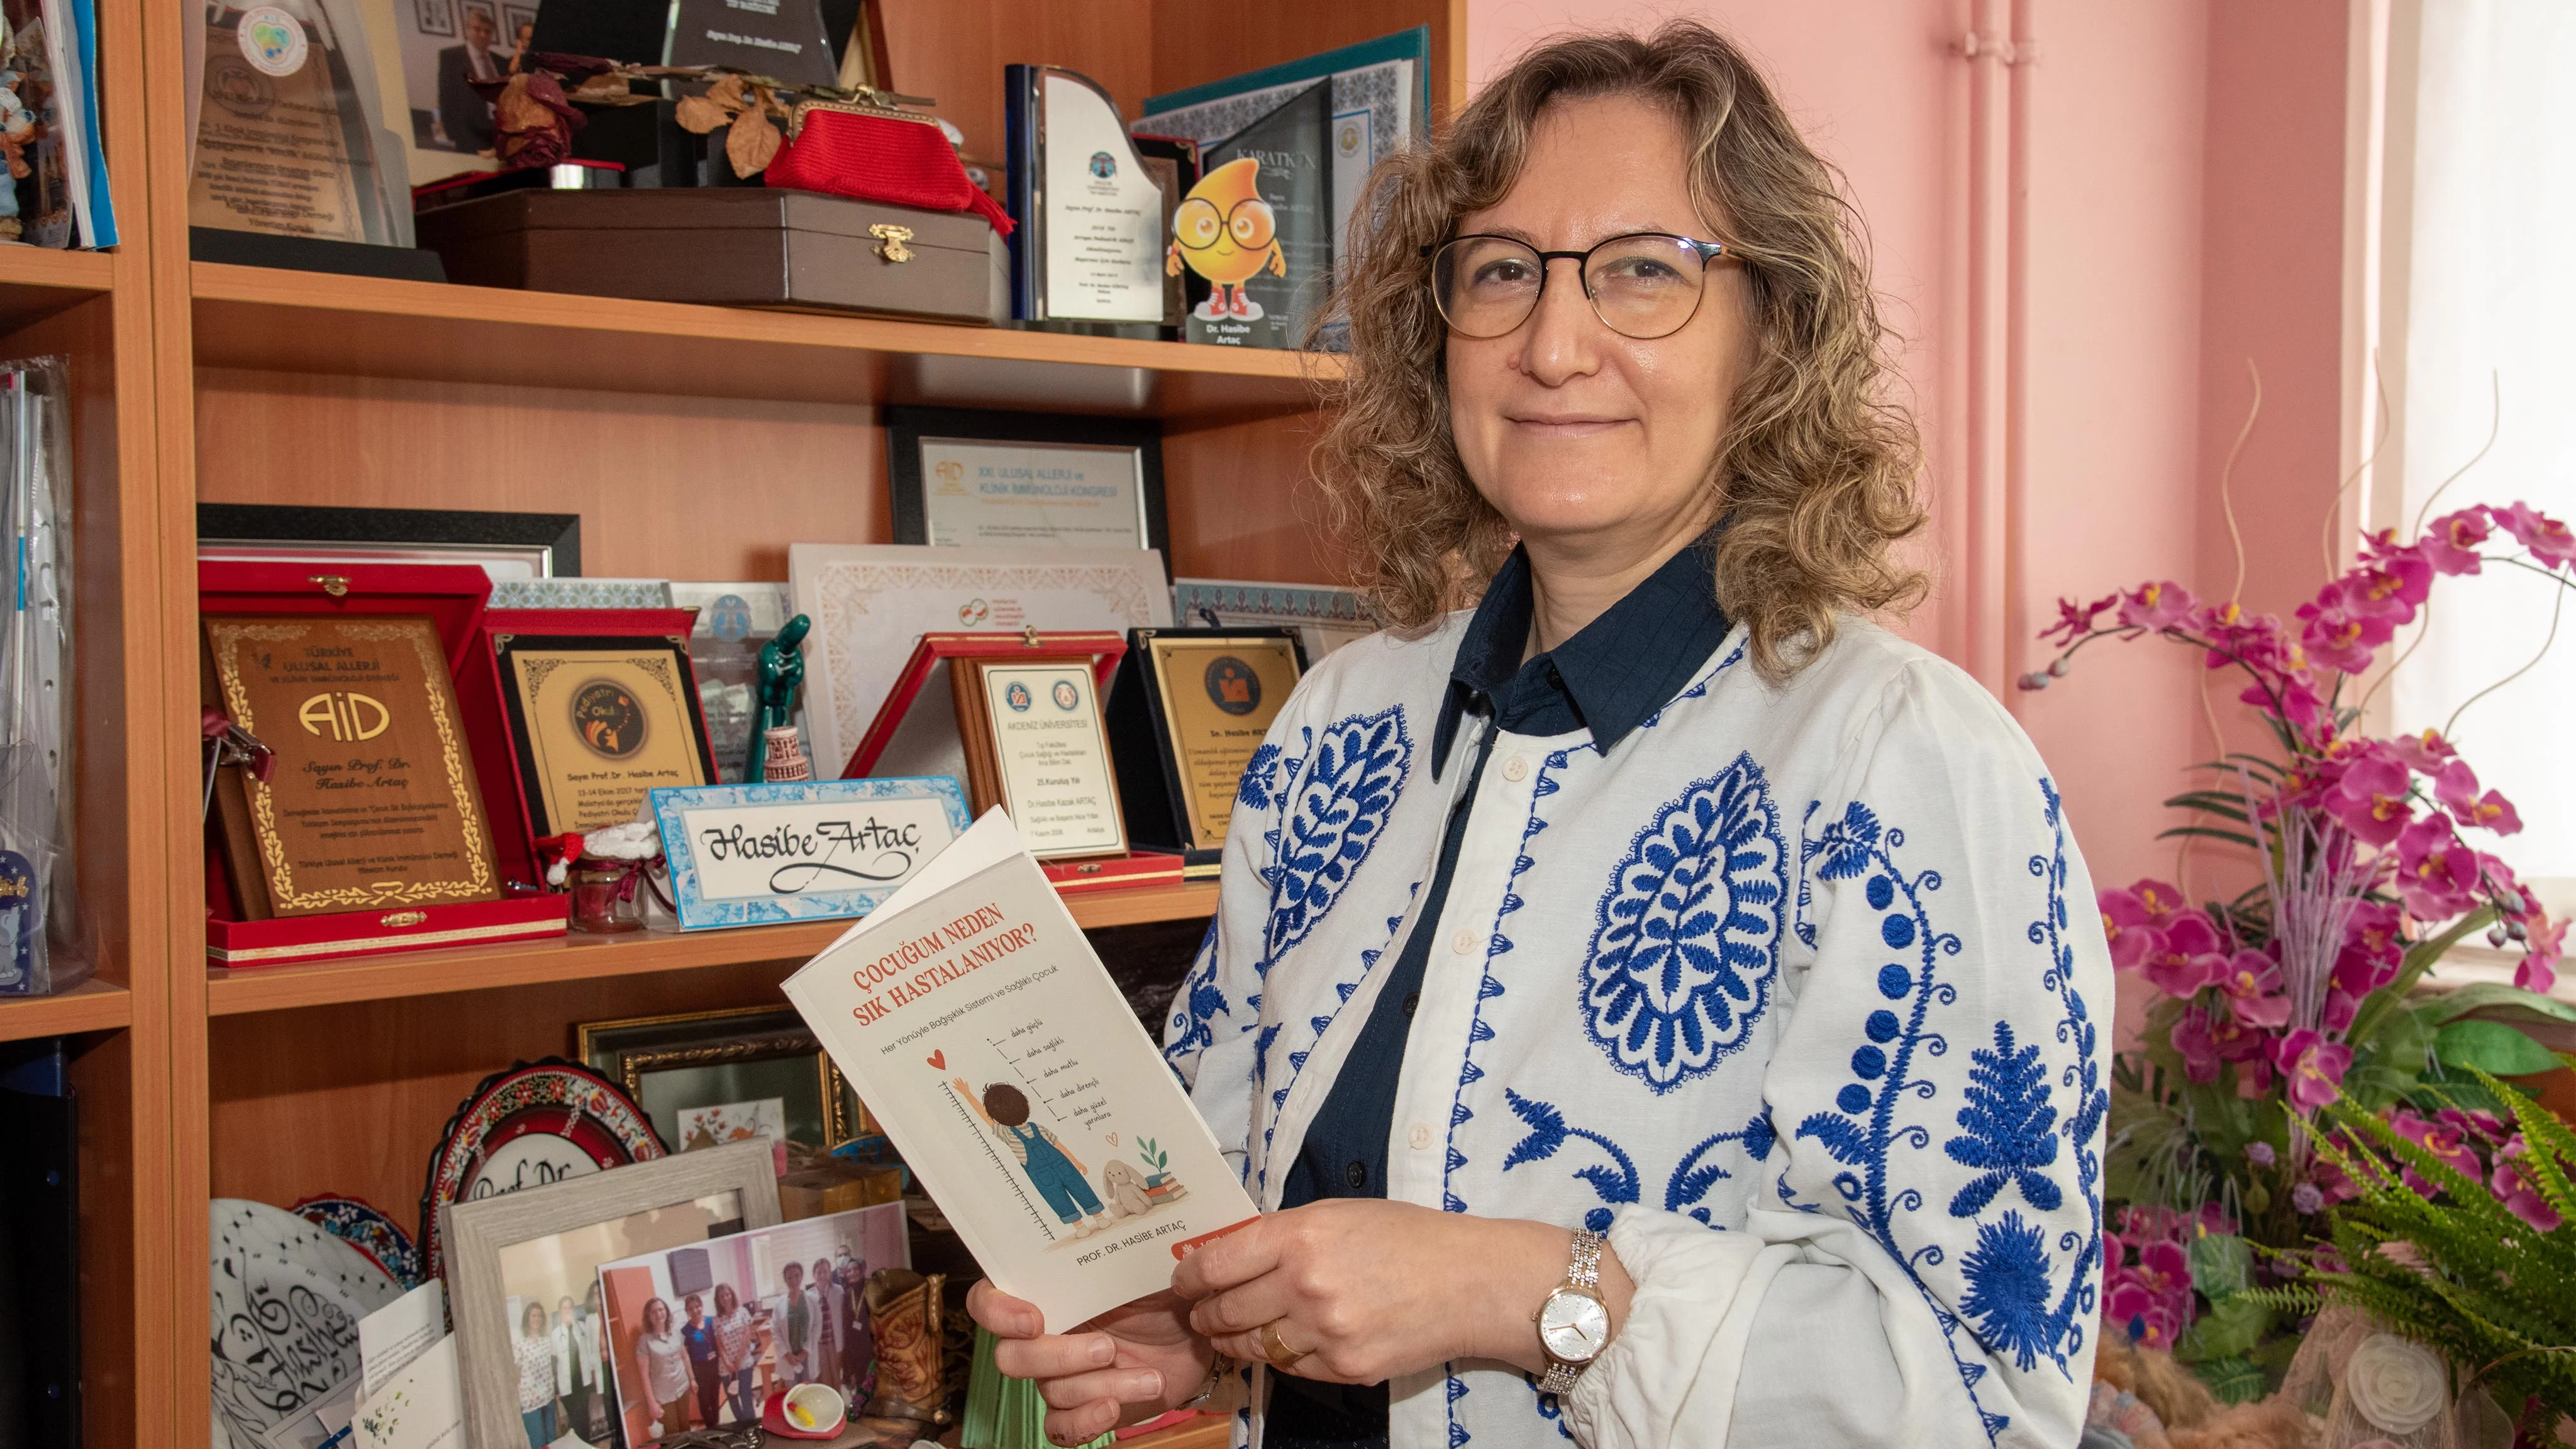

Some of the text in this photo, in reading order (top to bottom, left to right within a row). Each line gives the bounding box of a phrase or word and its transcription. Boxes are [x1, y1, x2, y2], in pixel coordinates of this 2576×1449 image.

[1206, 324, 1250, 334] Dr. Hasibe
[1216, 335, 1241, 345] Artaç
[283, 661, 332, 672] ULUSAL
[1008, 719, 1088, 730] AKDENİZ ÜNİVERSİTESİ
[303, 760, 343, 775] Sayın
[567, 773, 589, 782] Sayın
[627, 770, 653, 778] Hasibe
[315, 777, 364, 790] Hasibe
[700, 816, 921, 861] Hasibe Artaç
[853, 902, 1005, 994] ÇOCUĞUM NEDEN
[853, 922, 1037, 1026] SIK HASTALANIYOR?
[880, 963, 1059, 1055] Her Yönüyle Bağışıklık Sistemi ve Sağlıklı Çocuk
[1011, 1018, 1043, 1038] daha güçlü
[1026, 1036, 1065, 1058] daha sağlıklı
[1043, 1058, 1079, 1078] daha mutlu
[1060, 1077, 1100, 1099] daha dirençli
[1073, 1096, 1108, 1117] daha güzel
[1084, 1111, 1112, 1131] yarınlara
[1076, 1219, 1187, 1267] PROF. DR. HASİBE ARTAÇ
